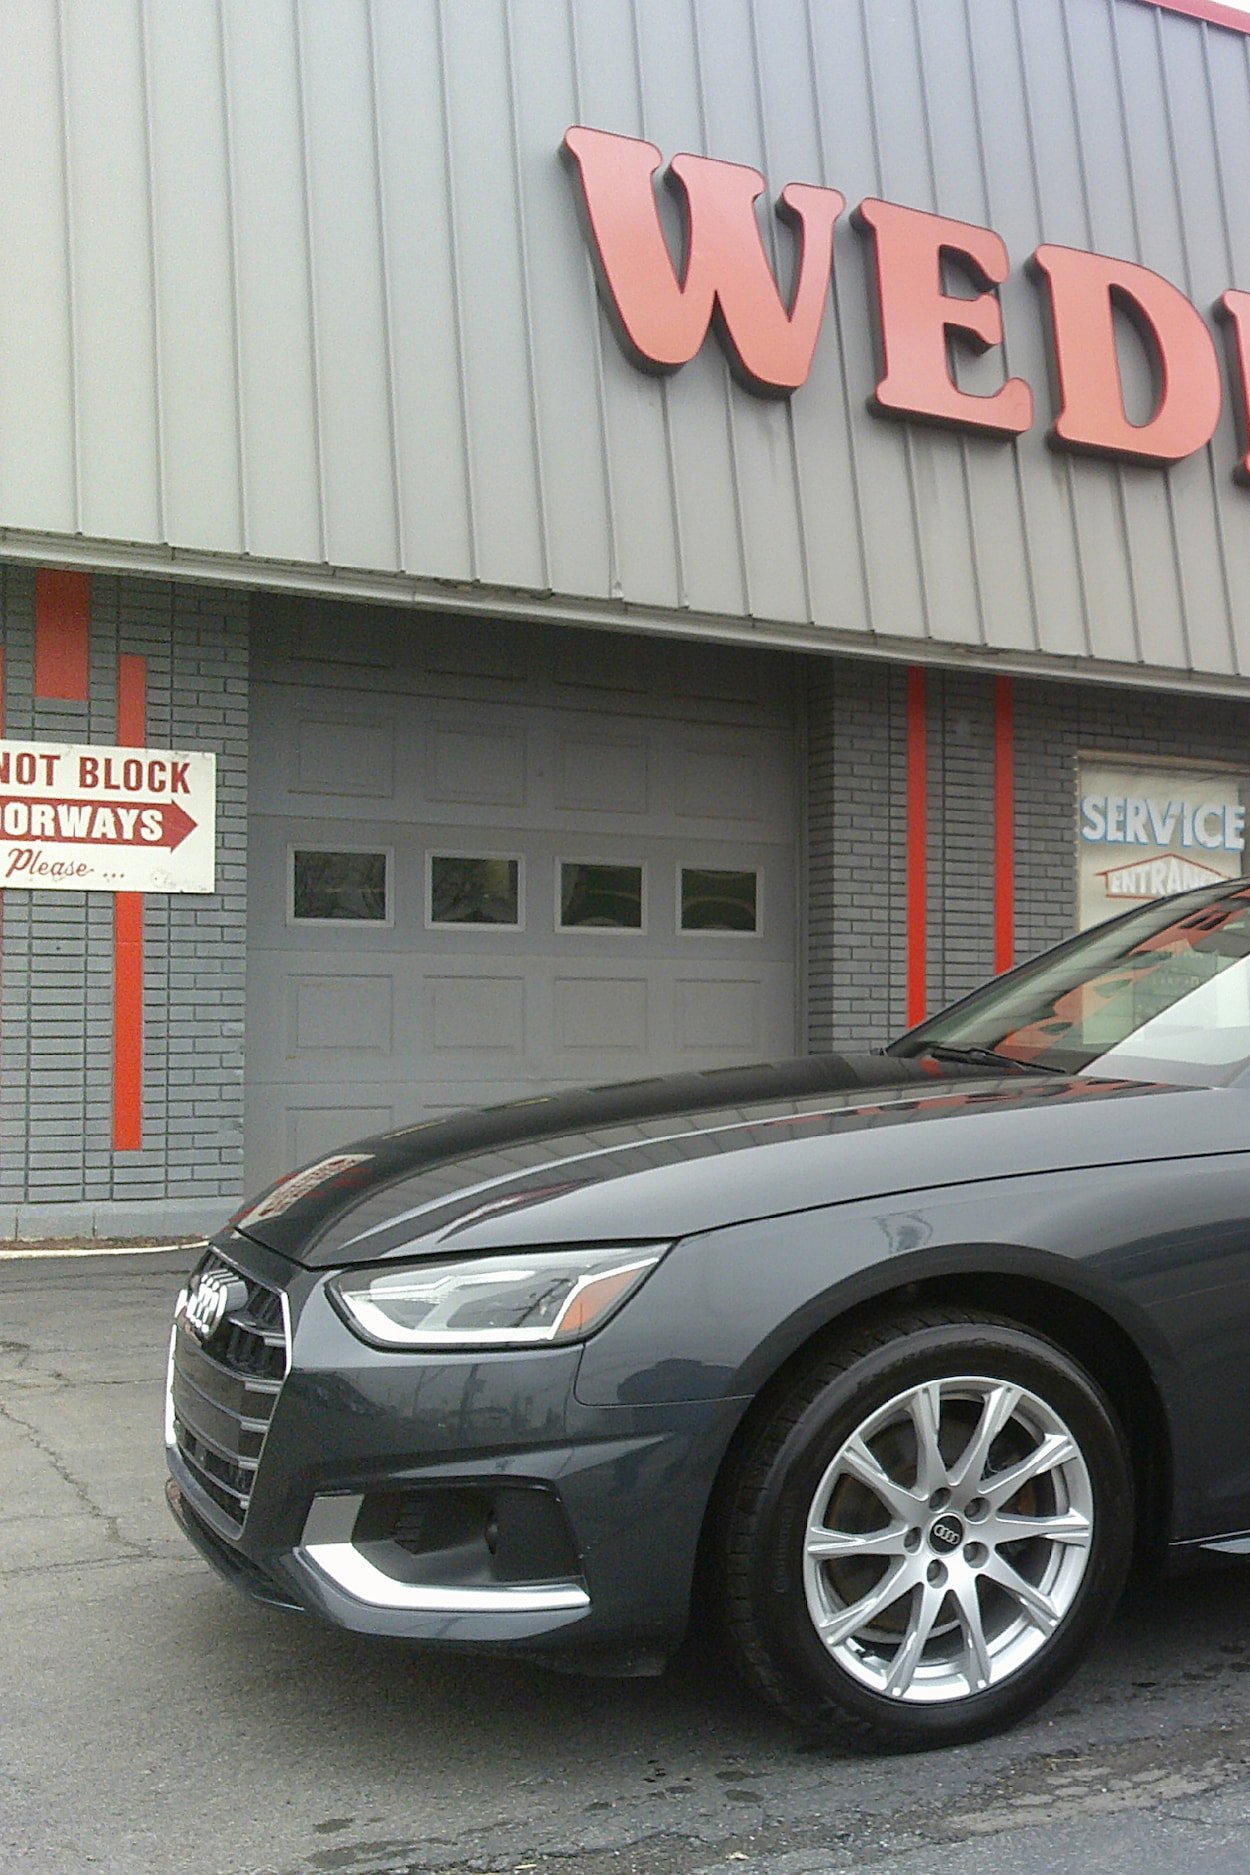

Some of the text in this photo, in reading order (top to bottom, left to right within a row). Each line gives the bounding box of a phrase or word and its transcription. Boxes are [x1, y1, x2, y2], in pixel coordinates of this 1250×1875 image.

[79, 757, 190, 794] BLOCK
[0, 801, 163, 841] ORWAYS
[1081, 795, 1246, 851] SERVICE
[5, 847, 95, 878] Please
[1111, 858, 1222, 894] ENTRAN
